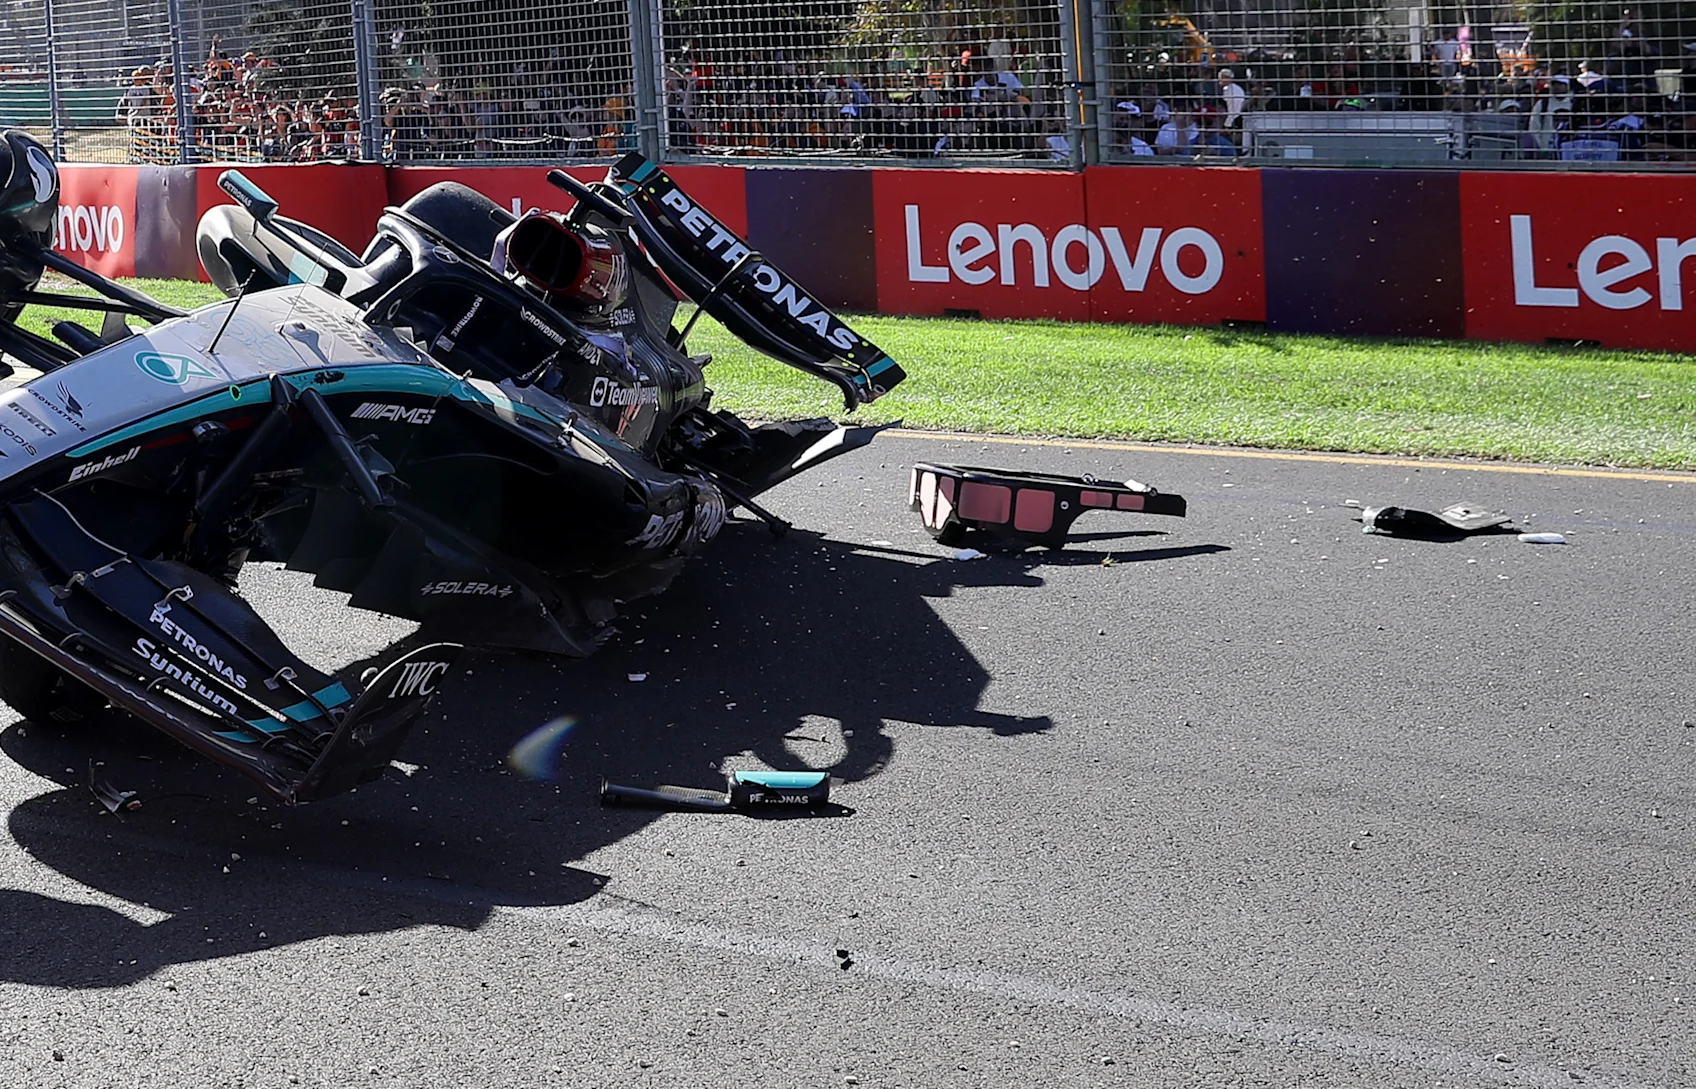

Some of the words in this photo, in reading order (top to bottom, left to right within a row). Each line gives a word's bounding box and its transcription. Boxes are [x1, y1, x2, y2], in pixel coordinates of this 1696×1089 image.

[223, 180, 252, 207] PETRONAS
[54, 205, 124, 253] novo
[905, 205, 1224, 295] Lenovo
[450, 294, 484, 338] ROWDSTRIKE
[8, 402, 57, 437] PIRELLI
[28, 389, 87, 433] CROWDSTRIKE
[378, 404, 436, 425] AMG
[68, 445, 142, 484] Einhell
[433, 581, 500, 596] SOLERA
[149, 609, 247, 689] PETRONAS
[132, 638, 237, 716] Syntium
[387, 662, 449, 700] IWC
[749, 791, 810, 805] PEONAS
